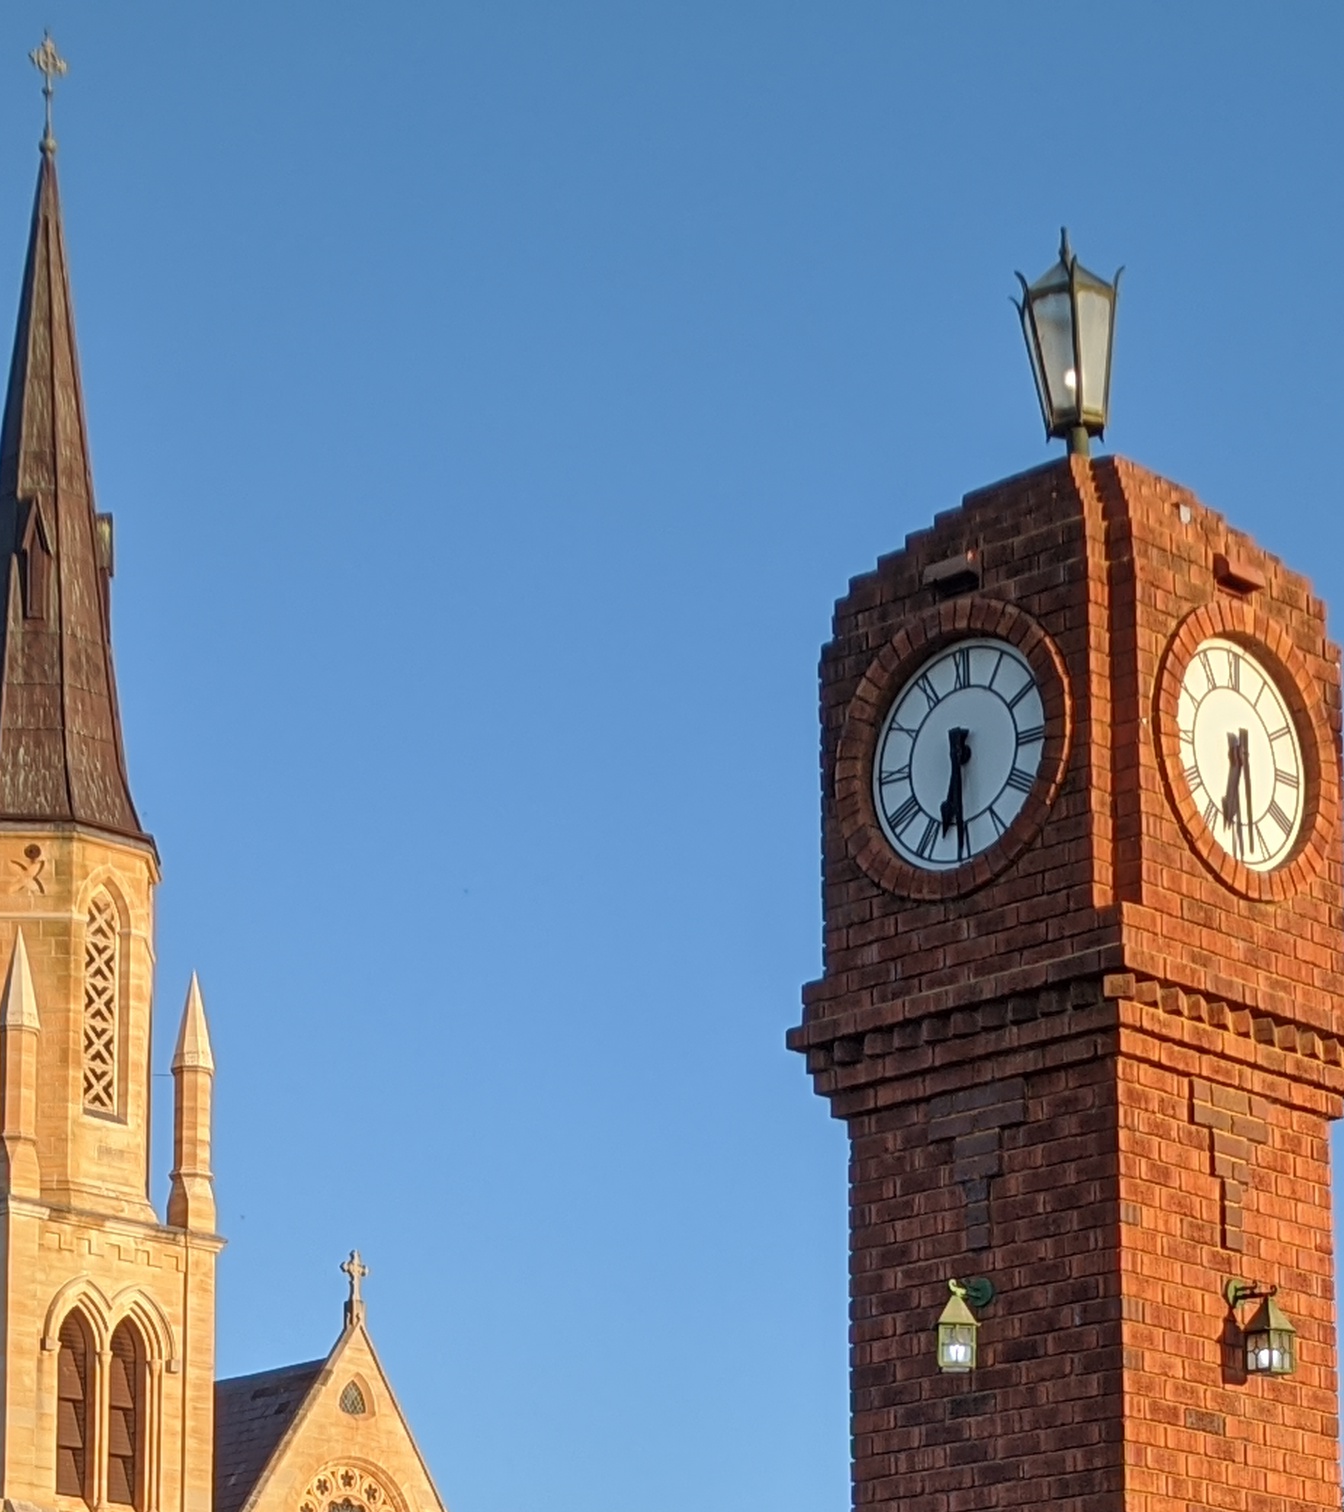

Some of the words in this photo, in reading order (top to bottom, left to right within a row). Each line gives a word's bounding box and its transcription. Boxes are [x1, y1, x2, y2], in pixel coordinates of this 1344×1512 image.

[953, 650, 970, 689] XII
[916, 673, 940, 710] XI
[1007, 678, 1036, 711] II
